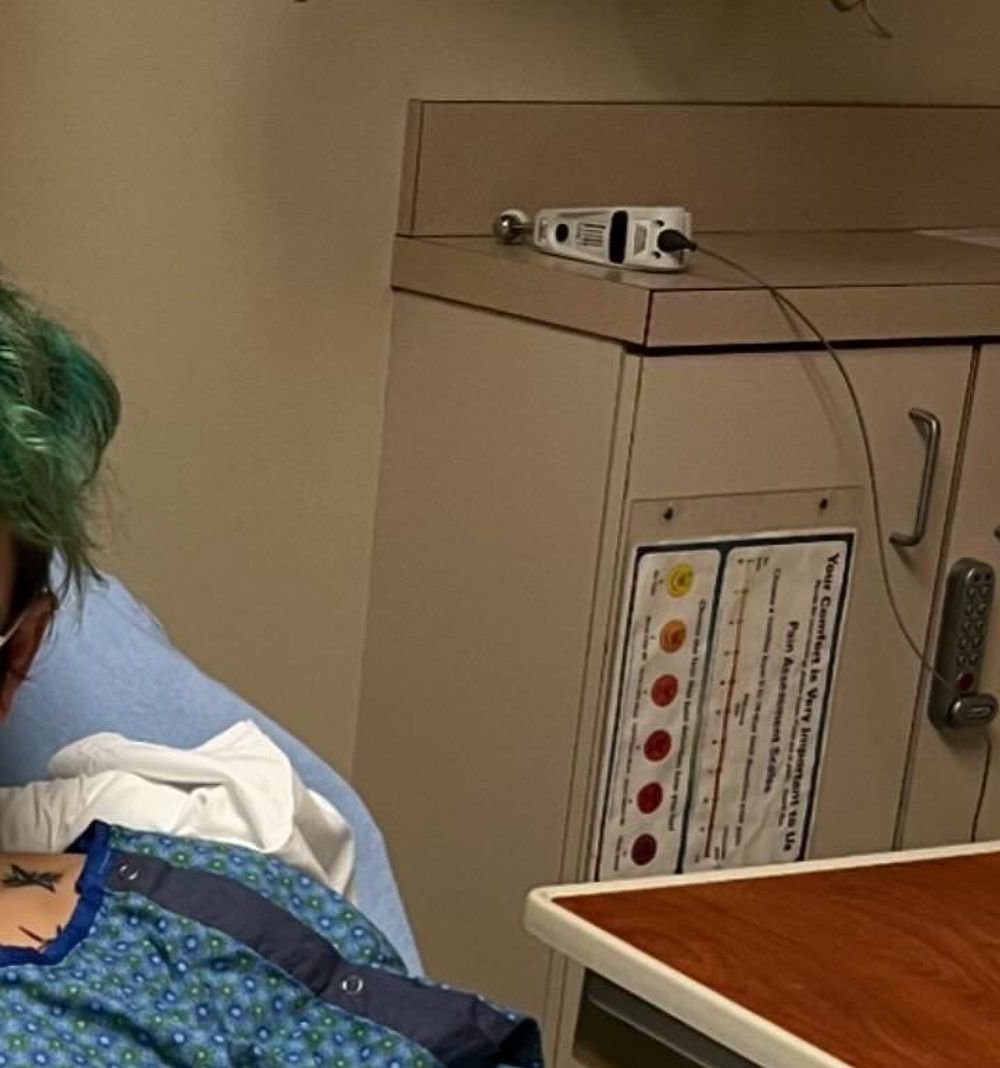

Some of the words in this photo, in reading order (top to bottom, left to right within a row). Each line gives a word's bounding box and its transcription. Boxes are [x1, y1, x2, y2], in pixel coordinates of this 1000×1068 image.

[824, 553, 841, 591] Your
[786, 621, 800, 653] Pain
[809, 596, 831, 664] Comfort
[802, 688, 818, 723] Very
[789, 727, 812, 806] Important
